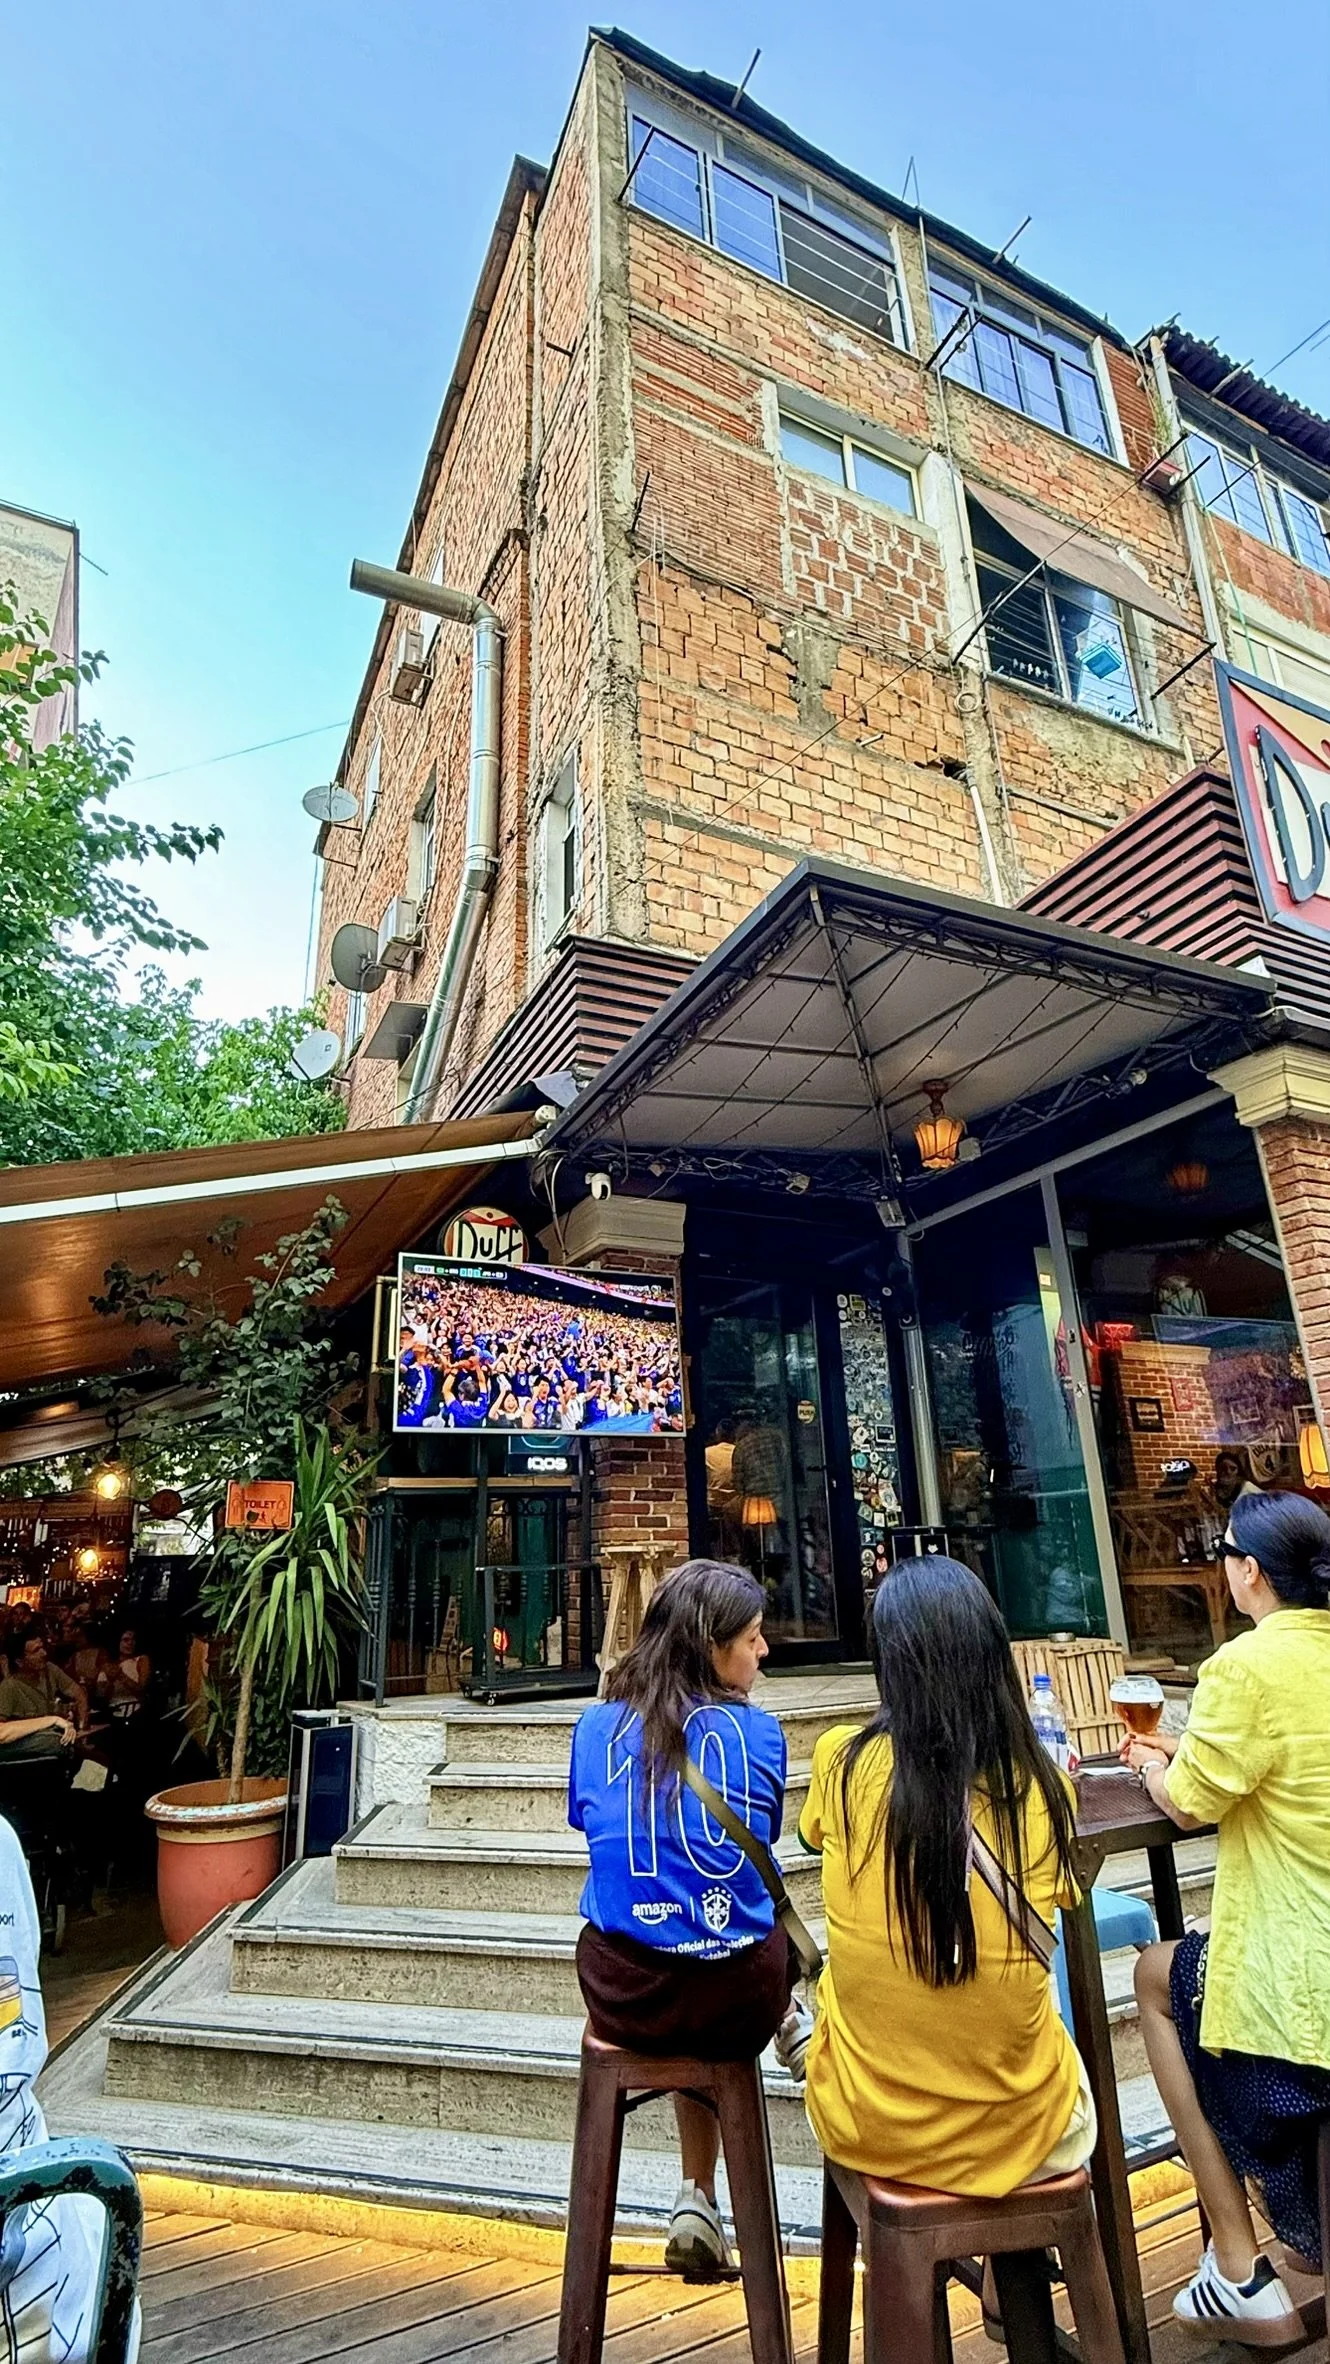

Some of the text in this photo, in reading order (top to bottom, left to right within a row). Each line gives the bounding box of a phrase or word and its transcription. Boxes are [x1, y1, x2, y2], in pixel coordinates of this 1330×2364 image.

[1256, 725, 1330, 904] D
[457, 1219, 523, 1262] Duff
[527, 1456, 568, 1471] IQOS
[244, 1500, 276, 1509] TOILET
[607, 1705, 751, 1880] 10
[632, 1902, 683, 1920] amazon
[677, 1939, 705, 1954] Oficial
